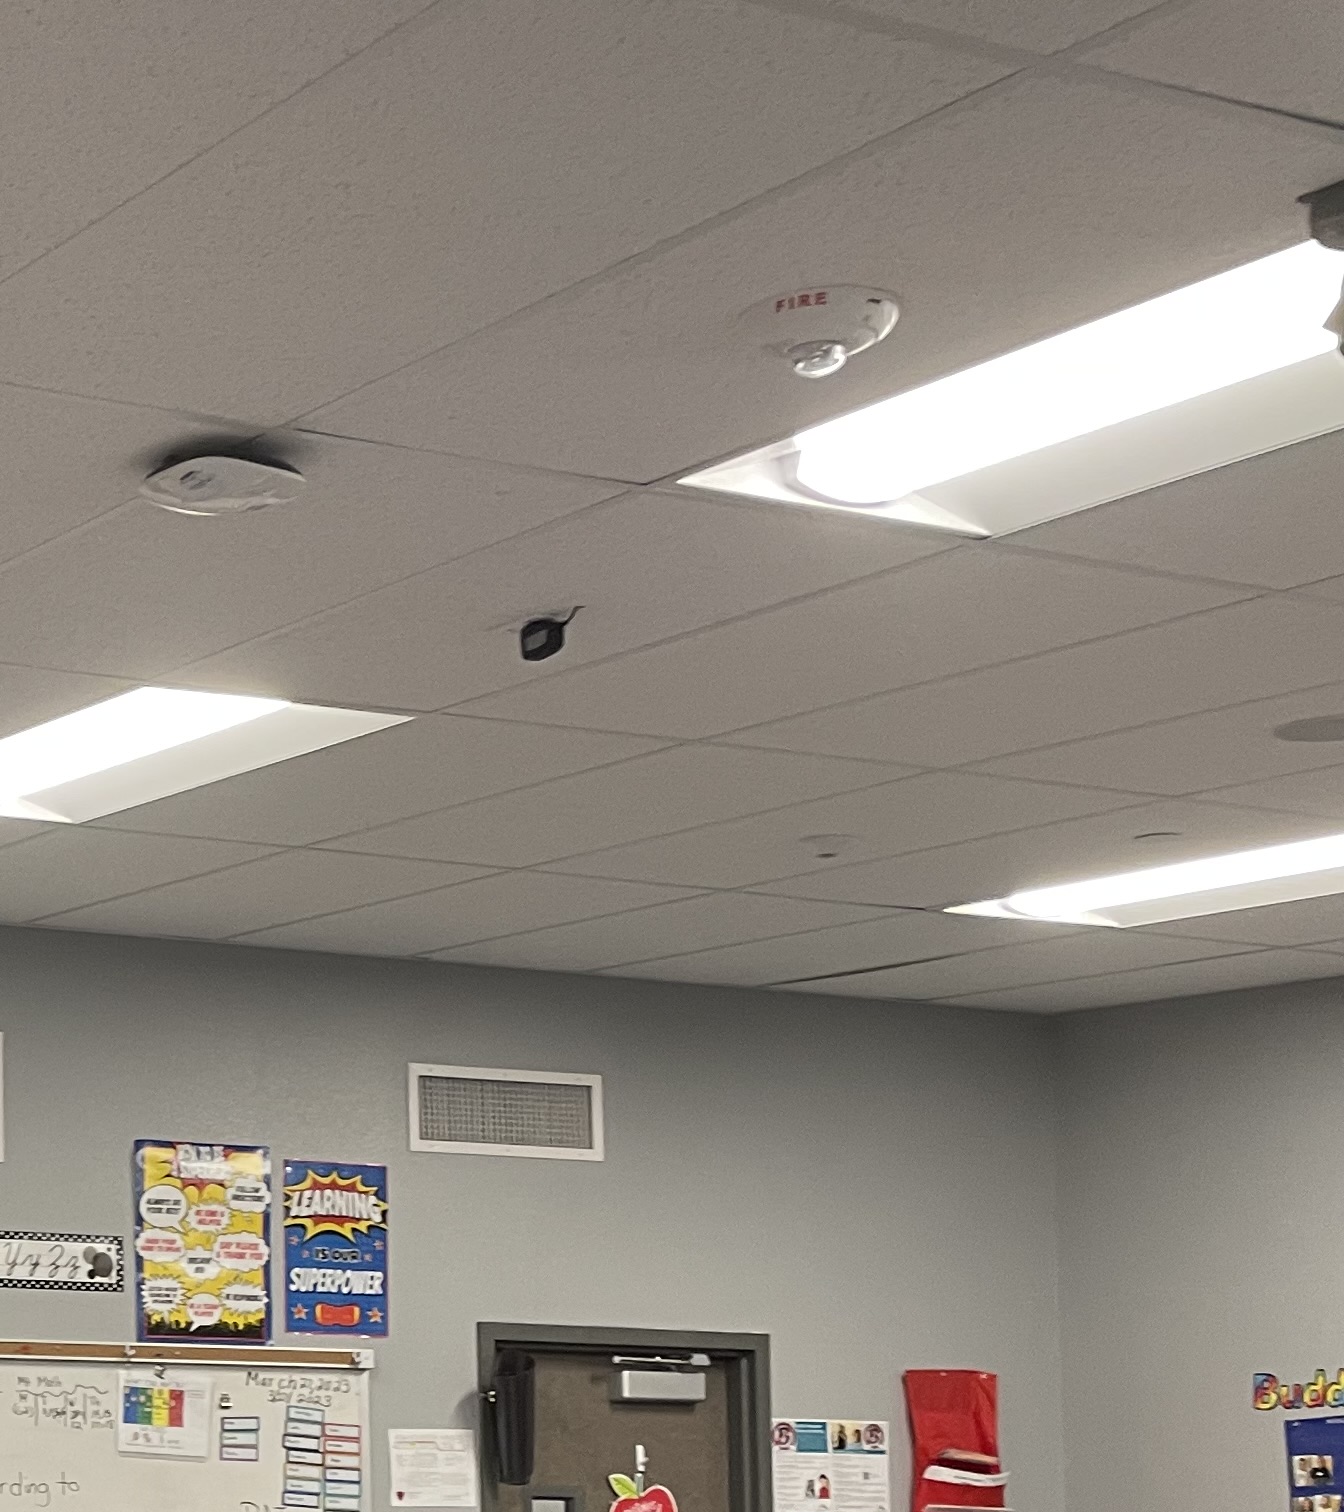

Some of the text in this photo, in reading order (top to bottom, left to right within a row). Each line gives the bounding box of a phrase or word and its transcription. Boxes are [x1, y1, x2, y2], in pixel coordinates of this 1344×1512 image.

[776, 292, 827, 313] FIRE
[289, 1189, 382, 1223] LEARNING
[4, 1242, 42, 1277] Yy
[289, 1267, 384, 1296] SUPERPOWER
[56, 1472, 80, 1496] to
